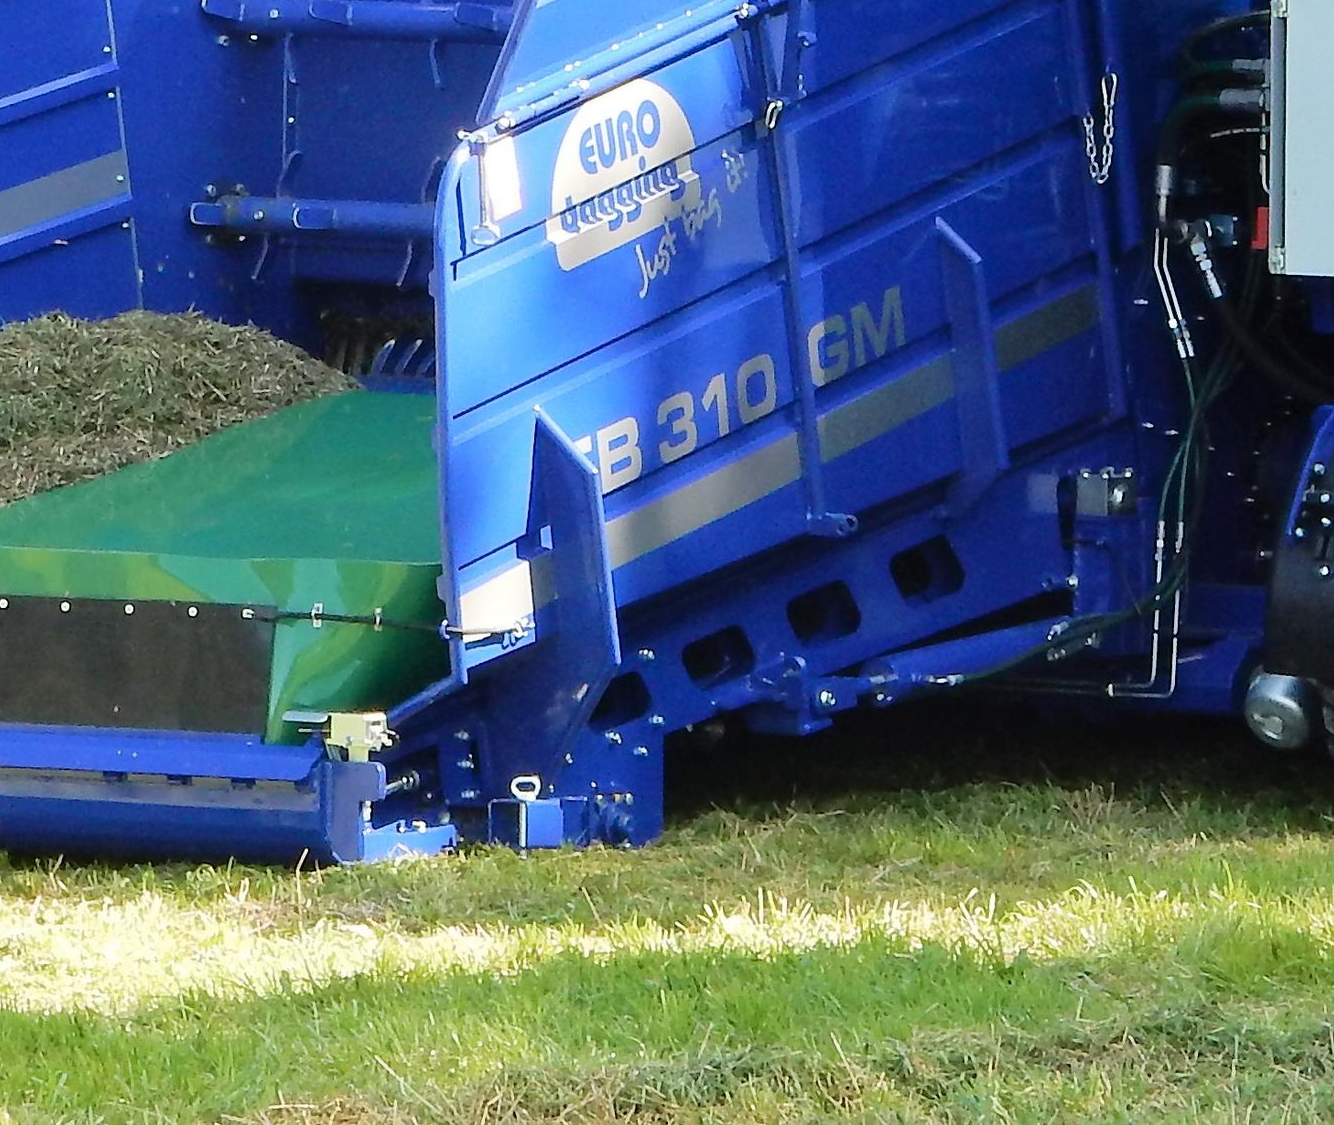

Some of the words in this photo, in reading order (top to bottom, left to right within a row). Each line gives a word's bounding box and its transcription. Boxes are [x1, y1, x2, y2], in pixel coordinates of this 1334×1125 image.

[578, 99, 662, 175] EURO
[558, 156, 687, 234] bagging
[634, 224, 677, 300] Just
[658, 352, 778, 464] 310
[806, 284, 907, 389] GM
